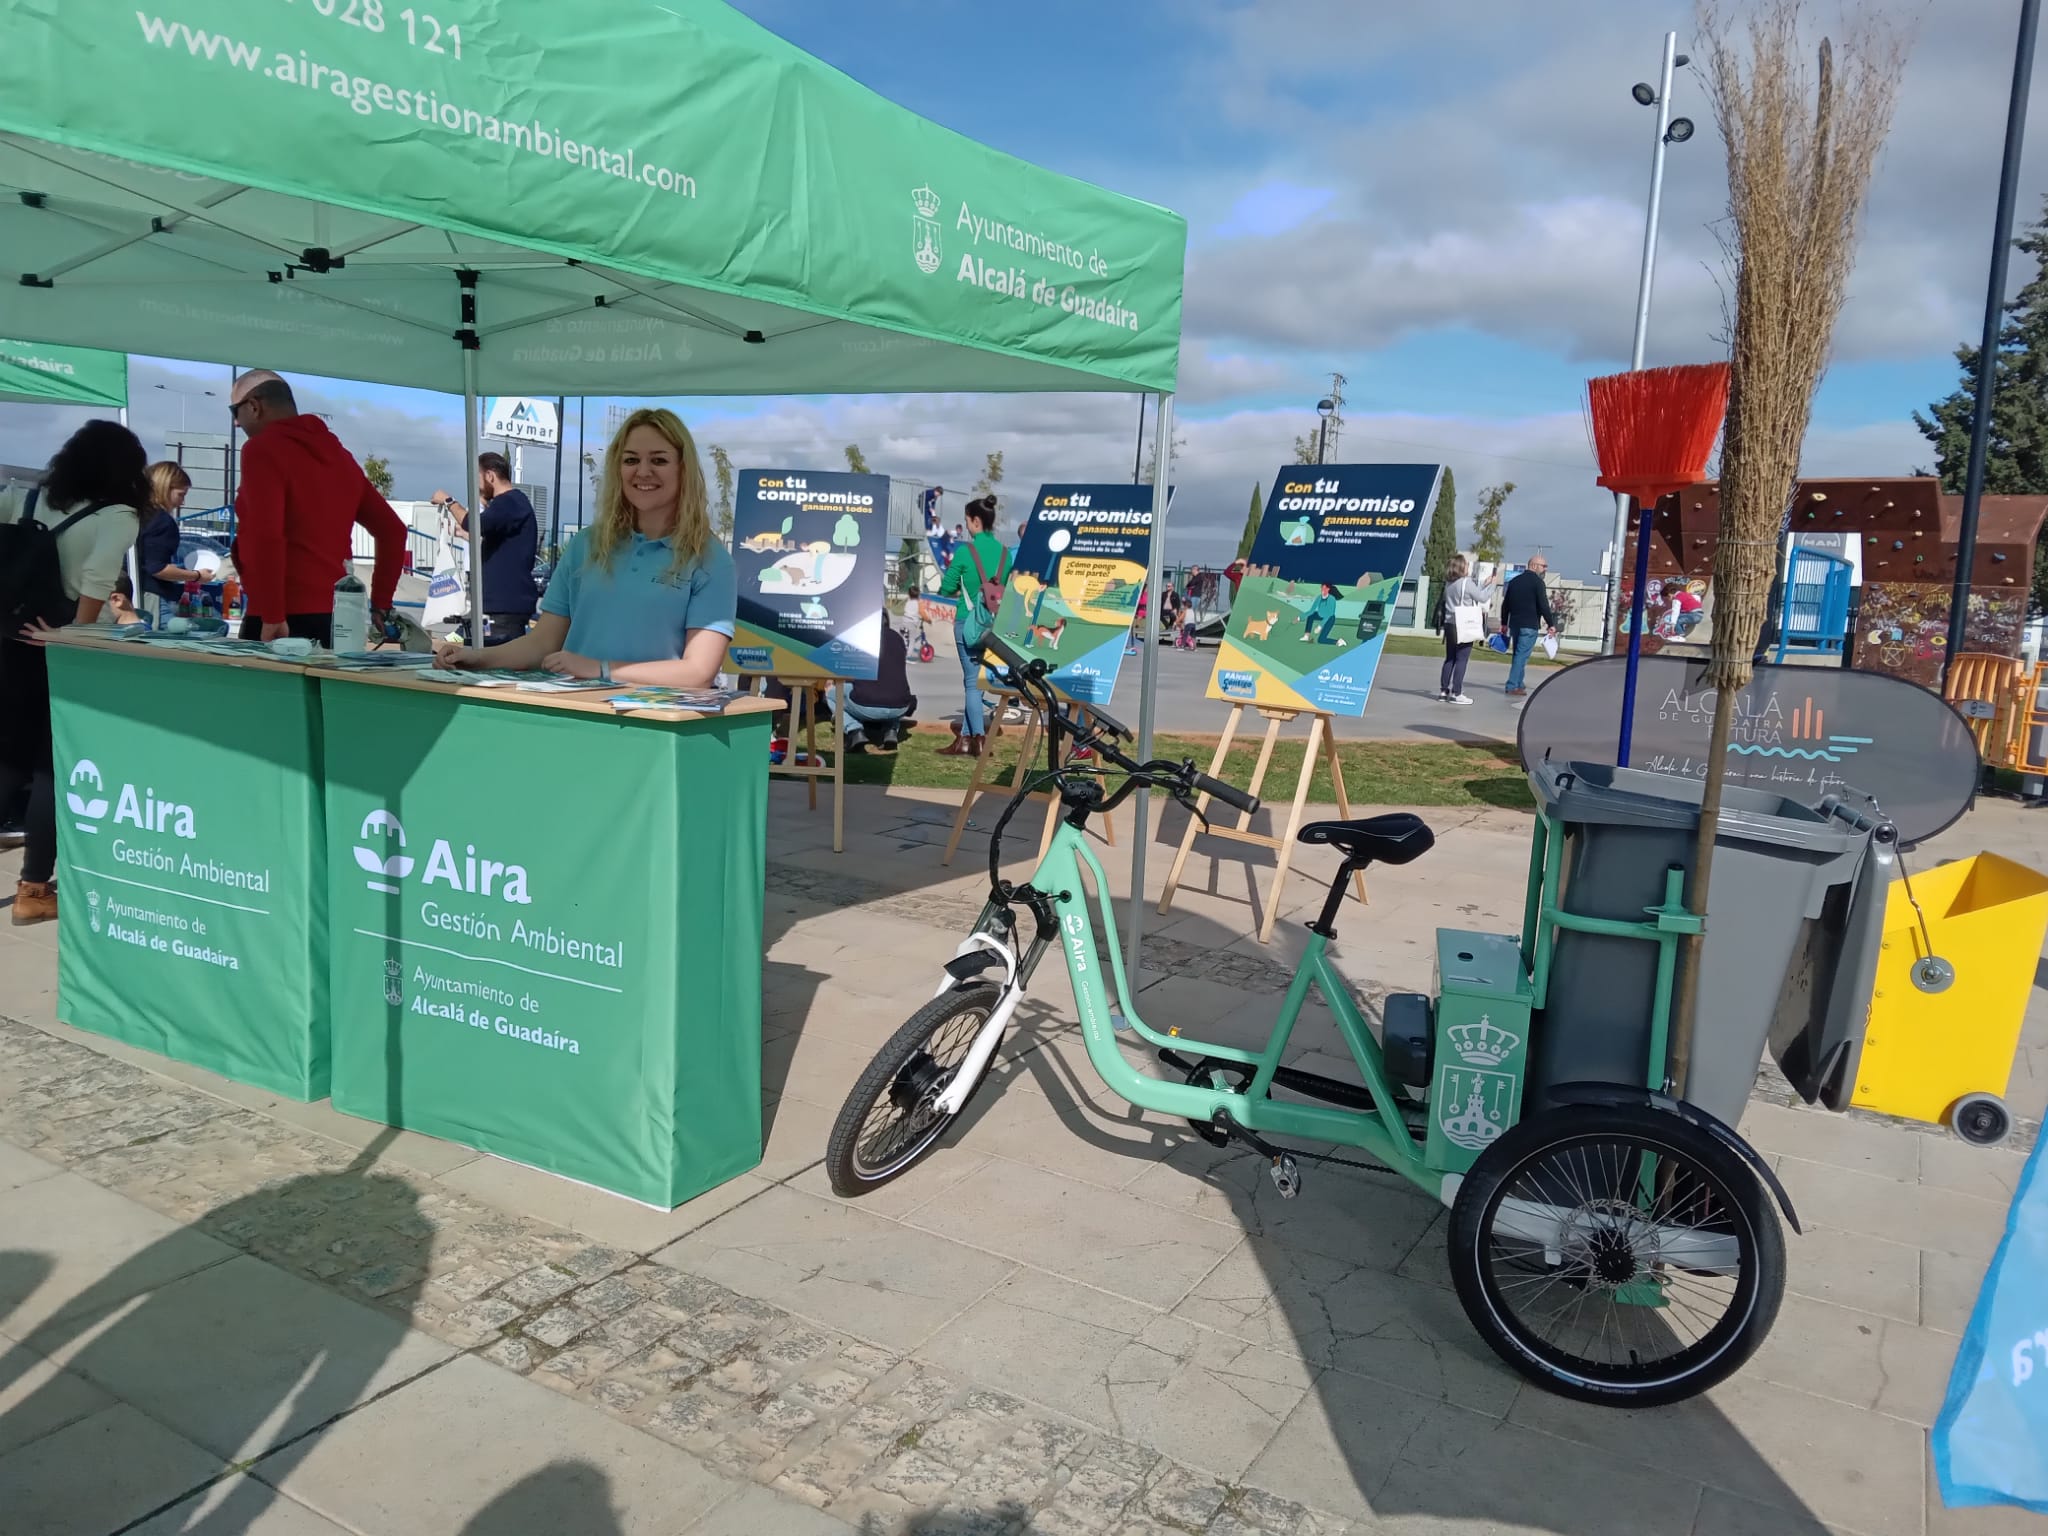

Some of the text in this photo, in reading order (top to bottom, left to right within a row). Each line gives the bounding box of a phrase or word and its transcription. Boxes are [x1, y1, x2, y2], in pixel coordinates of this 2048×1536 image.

[400, 8, 461, 60] 121
[136, 11, 697, 199] www.airagestionambiental.com
[957, 200, 1108, 277] Ayuntamiento de
[957, 253, 1138, 331] Alcalá de Guadaíra
[496, 420, 554, 438] adymar
[758, 476, 807, 489] Con tu
[1285, 478, 1340, 494] Con tu
[757, 490, 874, 505] compromiso
[802, 504, 873, 513] ganamos todos
[1044, 492, 1091, 507] Con tu
[1279, 494, 1415, 515] compromiso
[1038, 508, 1153, 526] compromiso
[1077, 525, 1150, 536] ganamos todos
[1323, 516, 1409, 527] ganamos todos
[1331, 672, 1353, 683] Aira
[1659, 711, 1783, 729] DE GUDAÍRA
[1707, 725, 1782, 744] FTURA
[113, 783, 198, 839] Aira
[112, 839, 270, 893] Gestión Ambiental
[421, 838, 532, 905] Aira
[106, 896, 207, 936] Ayuntamiento de
[107, 923, 239, 970] Alcalá de Guadaíra
[421, 901, 623, 968] Gestión Ambiental
[1071, 937, 1087, 972] Aira
[413, 965, 540, 1013] Ayuntamiento de
[411, 995, 580, 1055] Alcalá de Guadaíra
